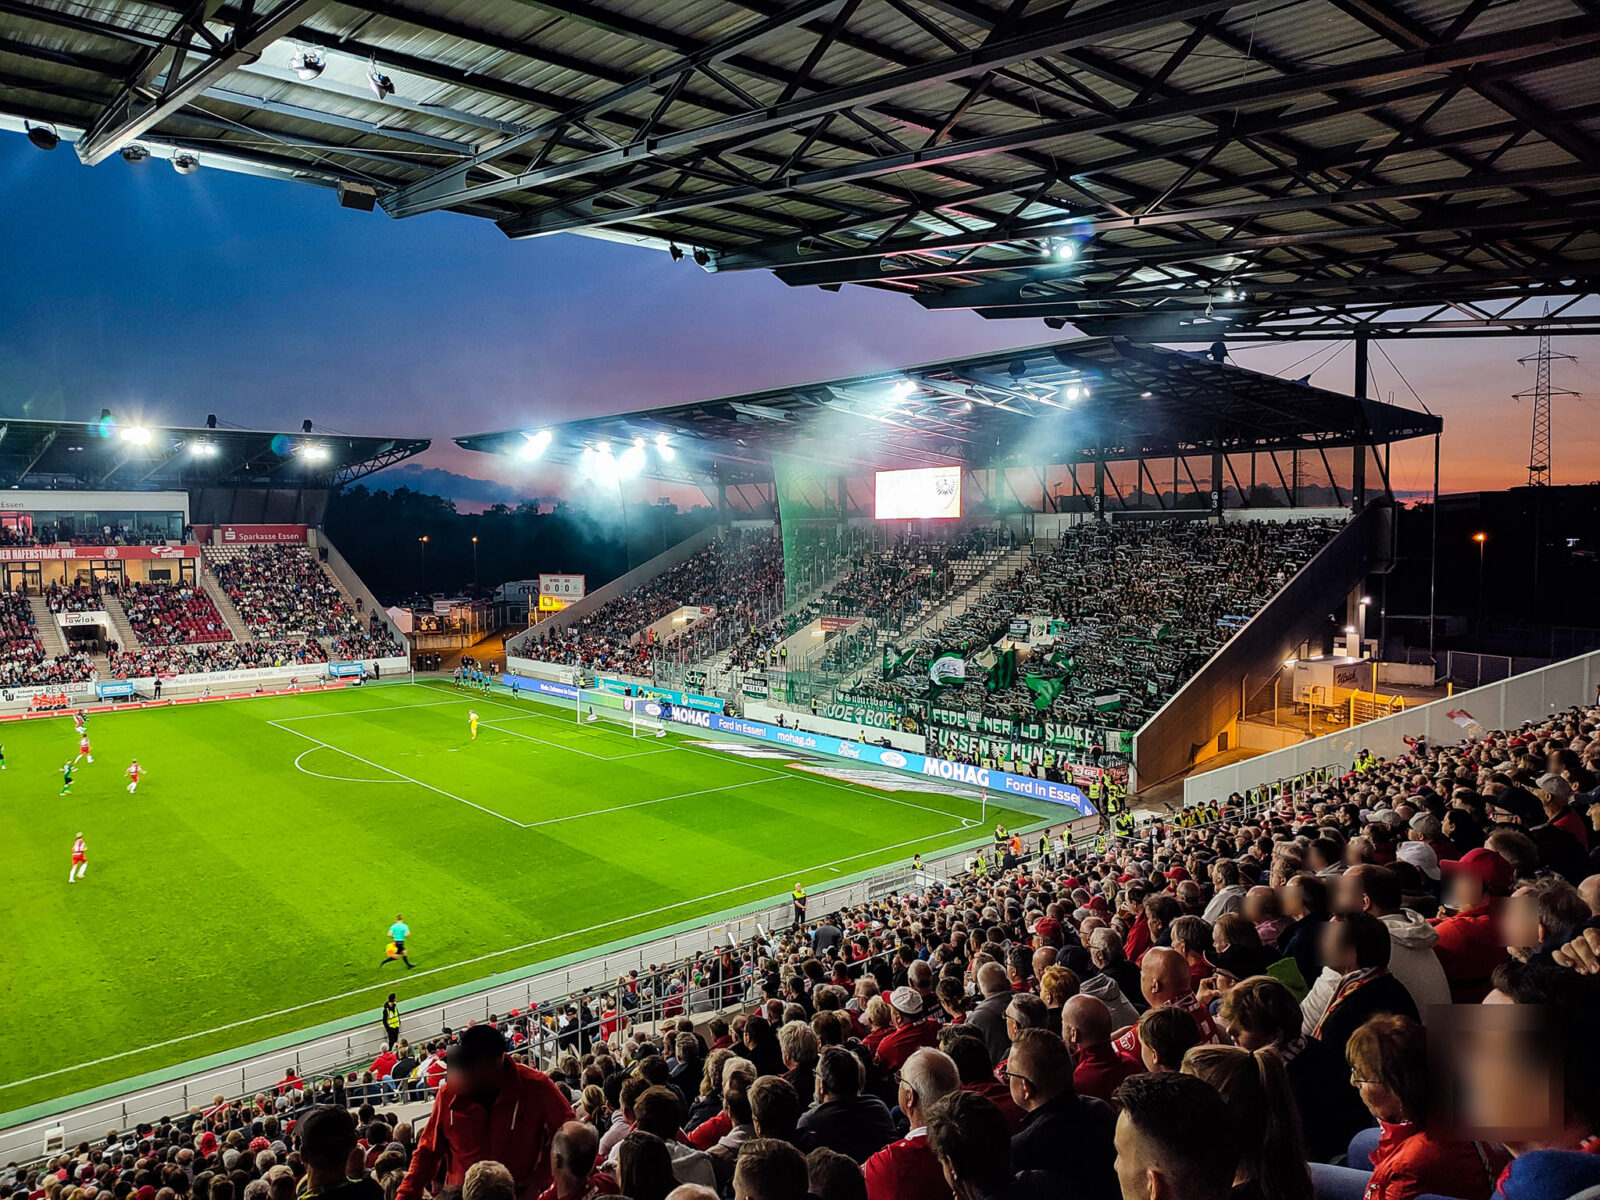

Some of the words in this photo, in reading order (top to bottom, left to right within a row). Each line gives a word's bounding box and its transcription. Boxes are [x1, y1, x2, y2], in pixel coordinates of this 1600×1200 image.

[239, 533, 276, 541] Sparkasse
[65, 614, 95, 623] Pawlak
[672, 706, 710, 727] MOHAG
[718, 719, 734, 732] Ford
[777, 732, 816, 748] mohag.de
[838, 741, 860, 759] Ford
[922, 757, 990, 787] MOHAG
[1005, 777, 1033, 793] Ford
[1035, 783, 1046, 796] in
